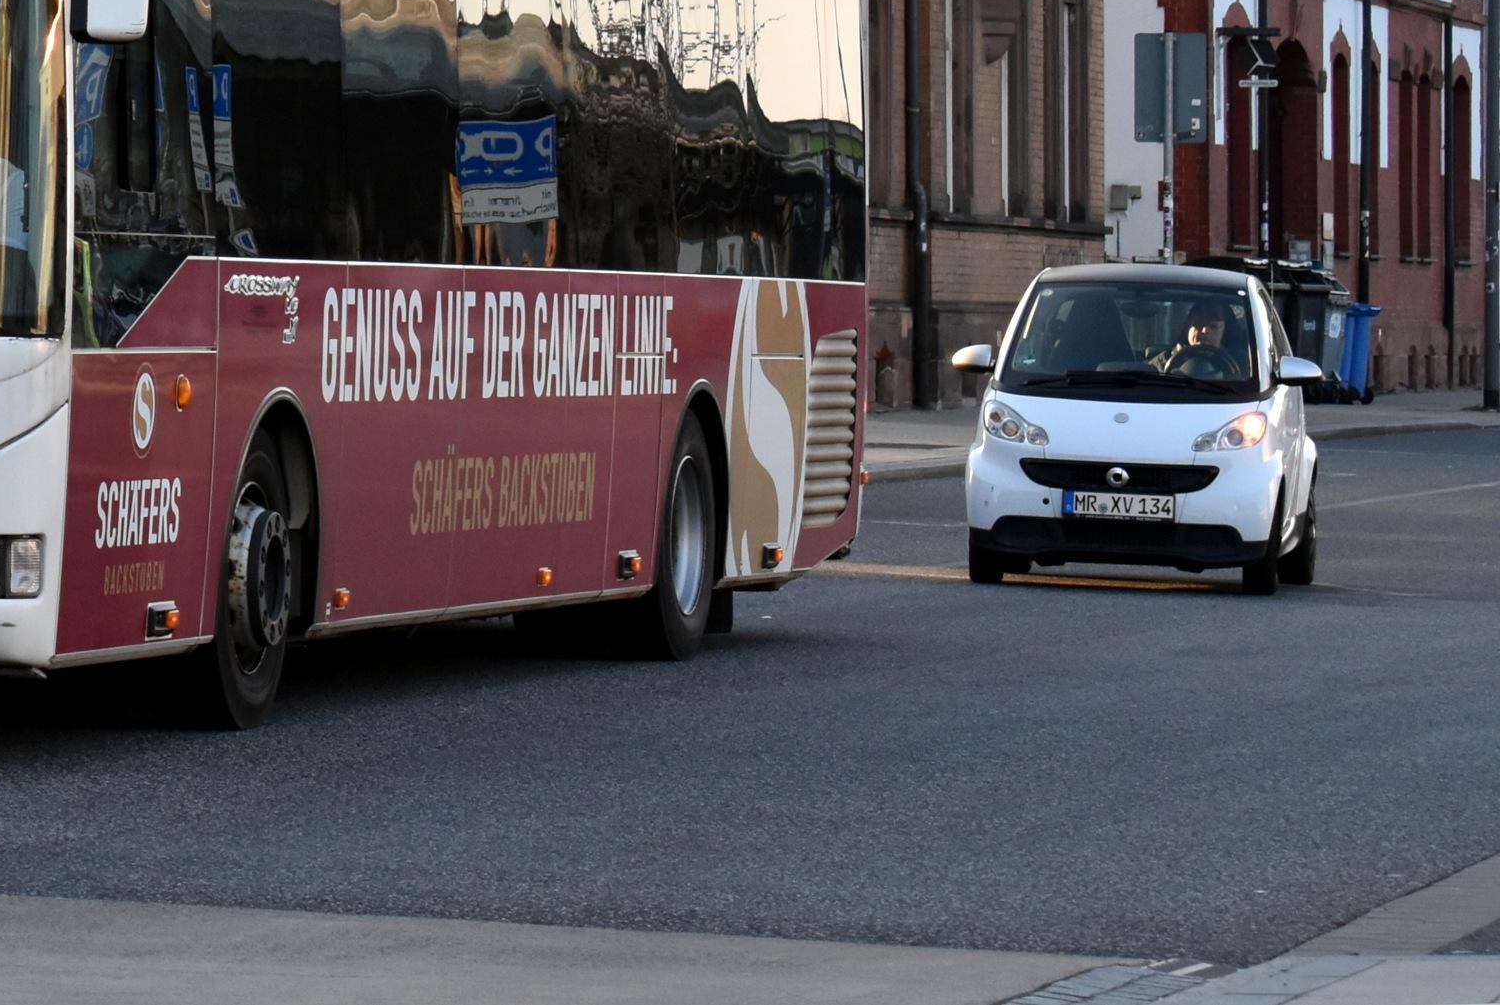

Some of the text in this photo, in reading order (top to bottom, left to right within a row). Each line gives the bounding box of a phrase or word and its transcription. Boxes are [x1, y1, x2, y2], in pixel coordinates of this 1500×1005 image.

[224, 274, 300, 298] CROSSWAY
[321, 287, 423, 403] GENUSS
[428, 290, 476, 400] AUF
[482, 291, 526, 399] DER
[532, 292, 615, 398] GANZEN
[95, 477, 181, 549] SCHÄFERS
[410, 443, 596, 535] SCHÄFERS BACKSTUBEN
[1075, 495, 1097, 512] MR
[1111, 496, 1134, 514] XV
[1138, 498, 1172, 515] 134
[103, 560, 165, 596] BACKSTUBEN
